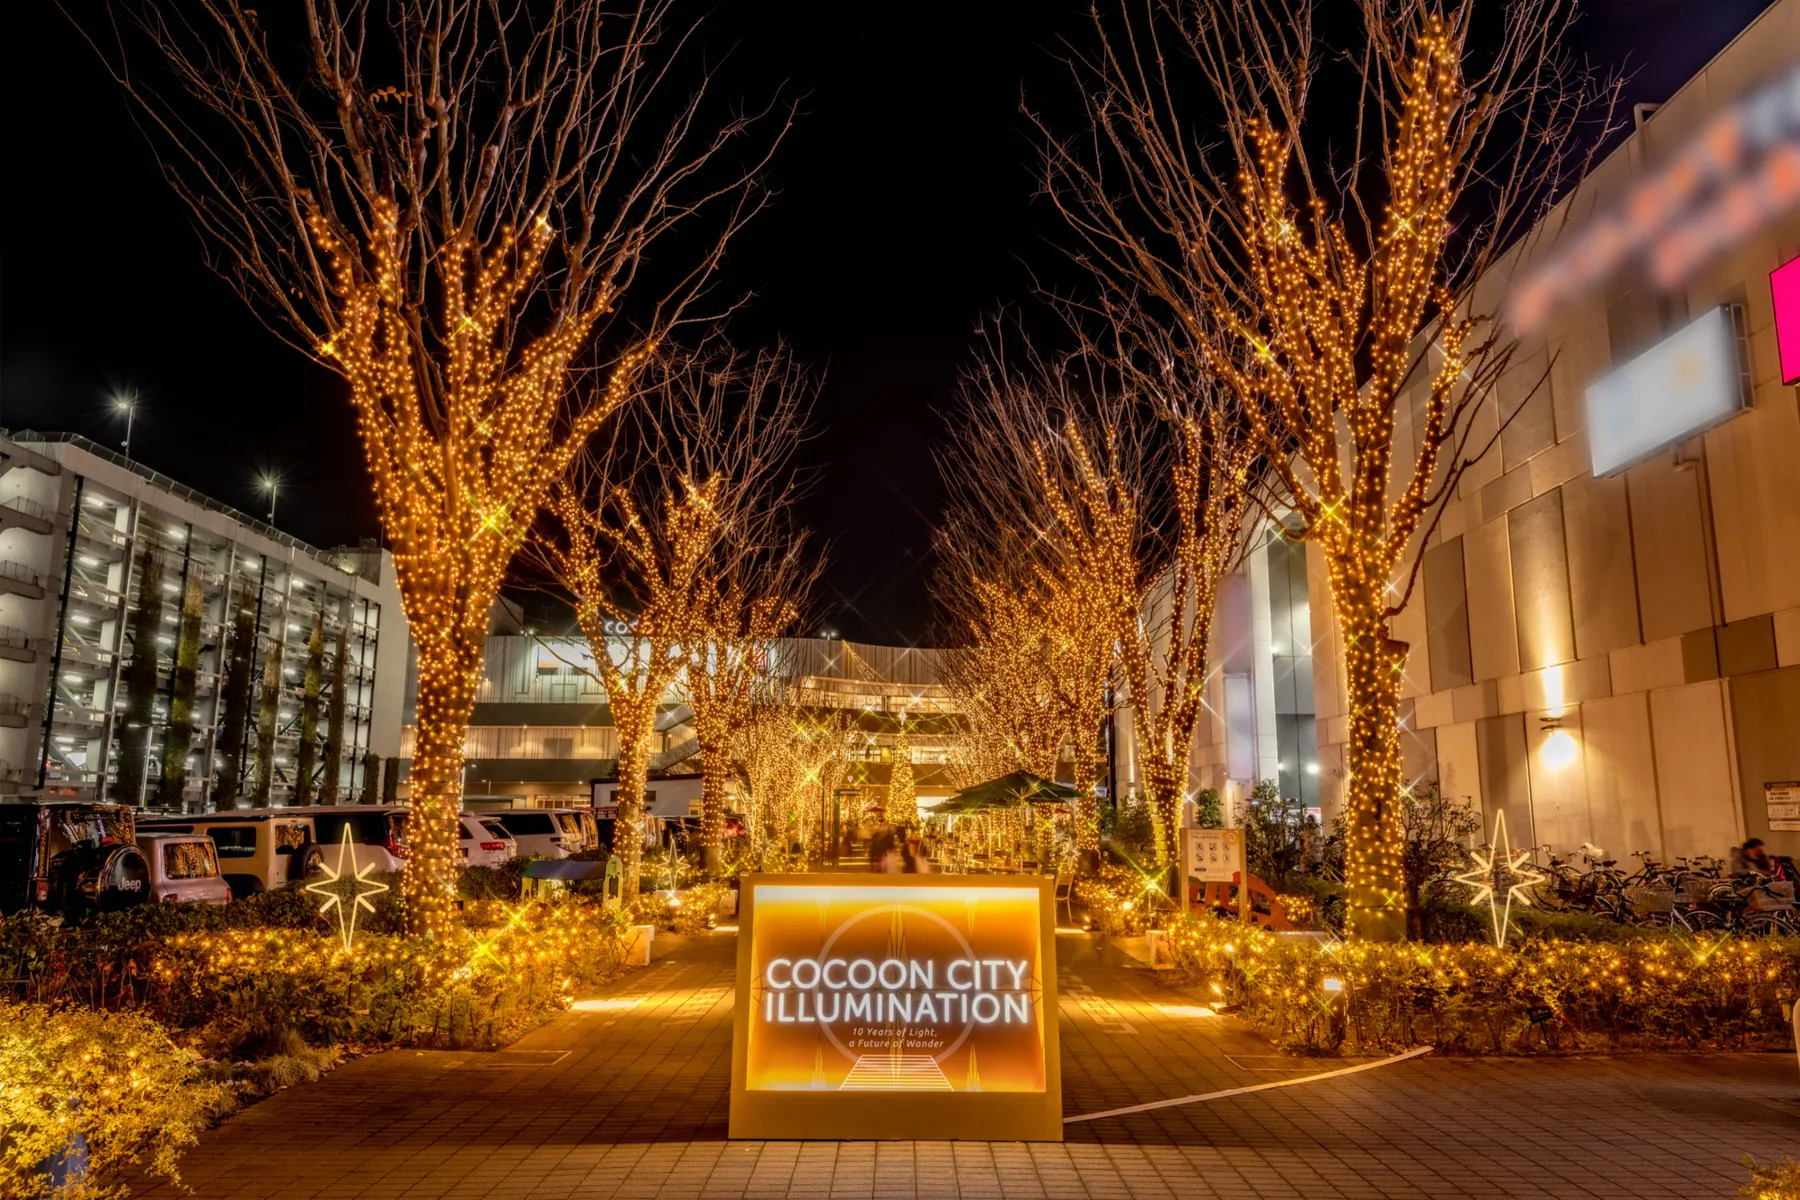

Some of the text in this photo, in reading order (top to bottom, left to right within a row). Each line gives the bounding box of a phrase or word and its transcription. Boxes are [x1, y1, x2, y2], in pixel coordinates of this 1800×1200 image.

[118, 877, 141, 892] Jeep
[766, 959, 1027, 990] COCOON CITY
[765, 993, 1028, 1023] ILLUMINATION
[853, 1028, 938, 1037] 10 Years of Light,
[858, 1039, 890, 1047] Future
[893, 1039, 904, 1048] of
[906, 1039, 944, 1048] Wonder
